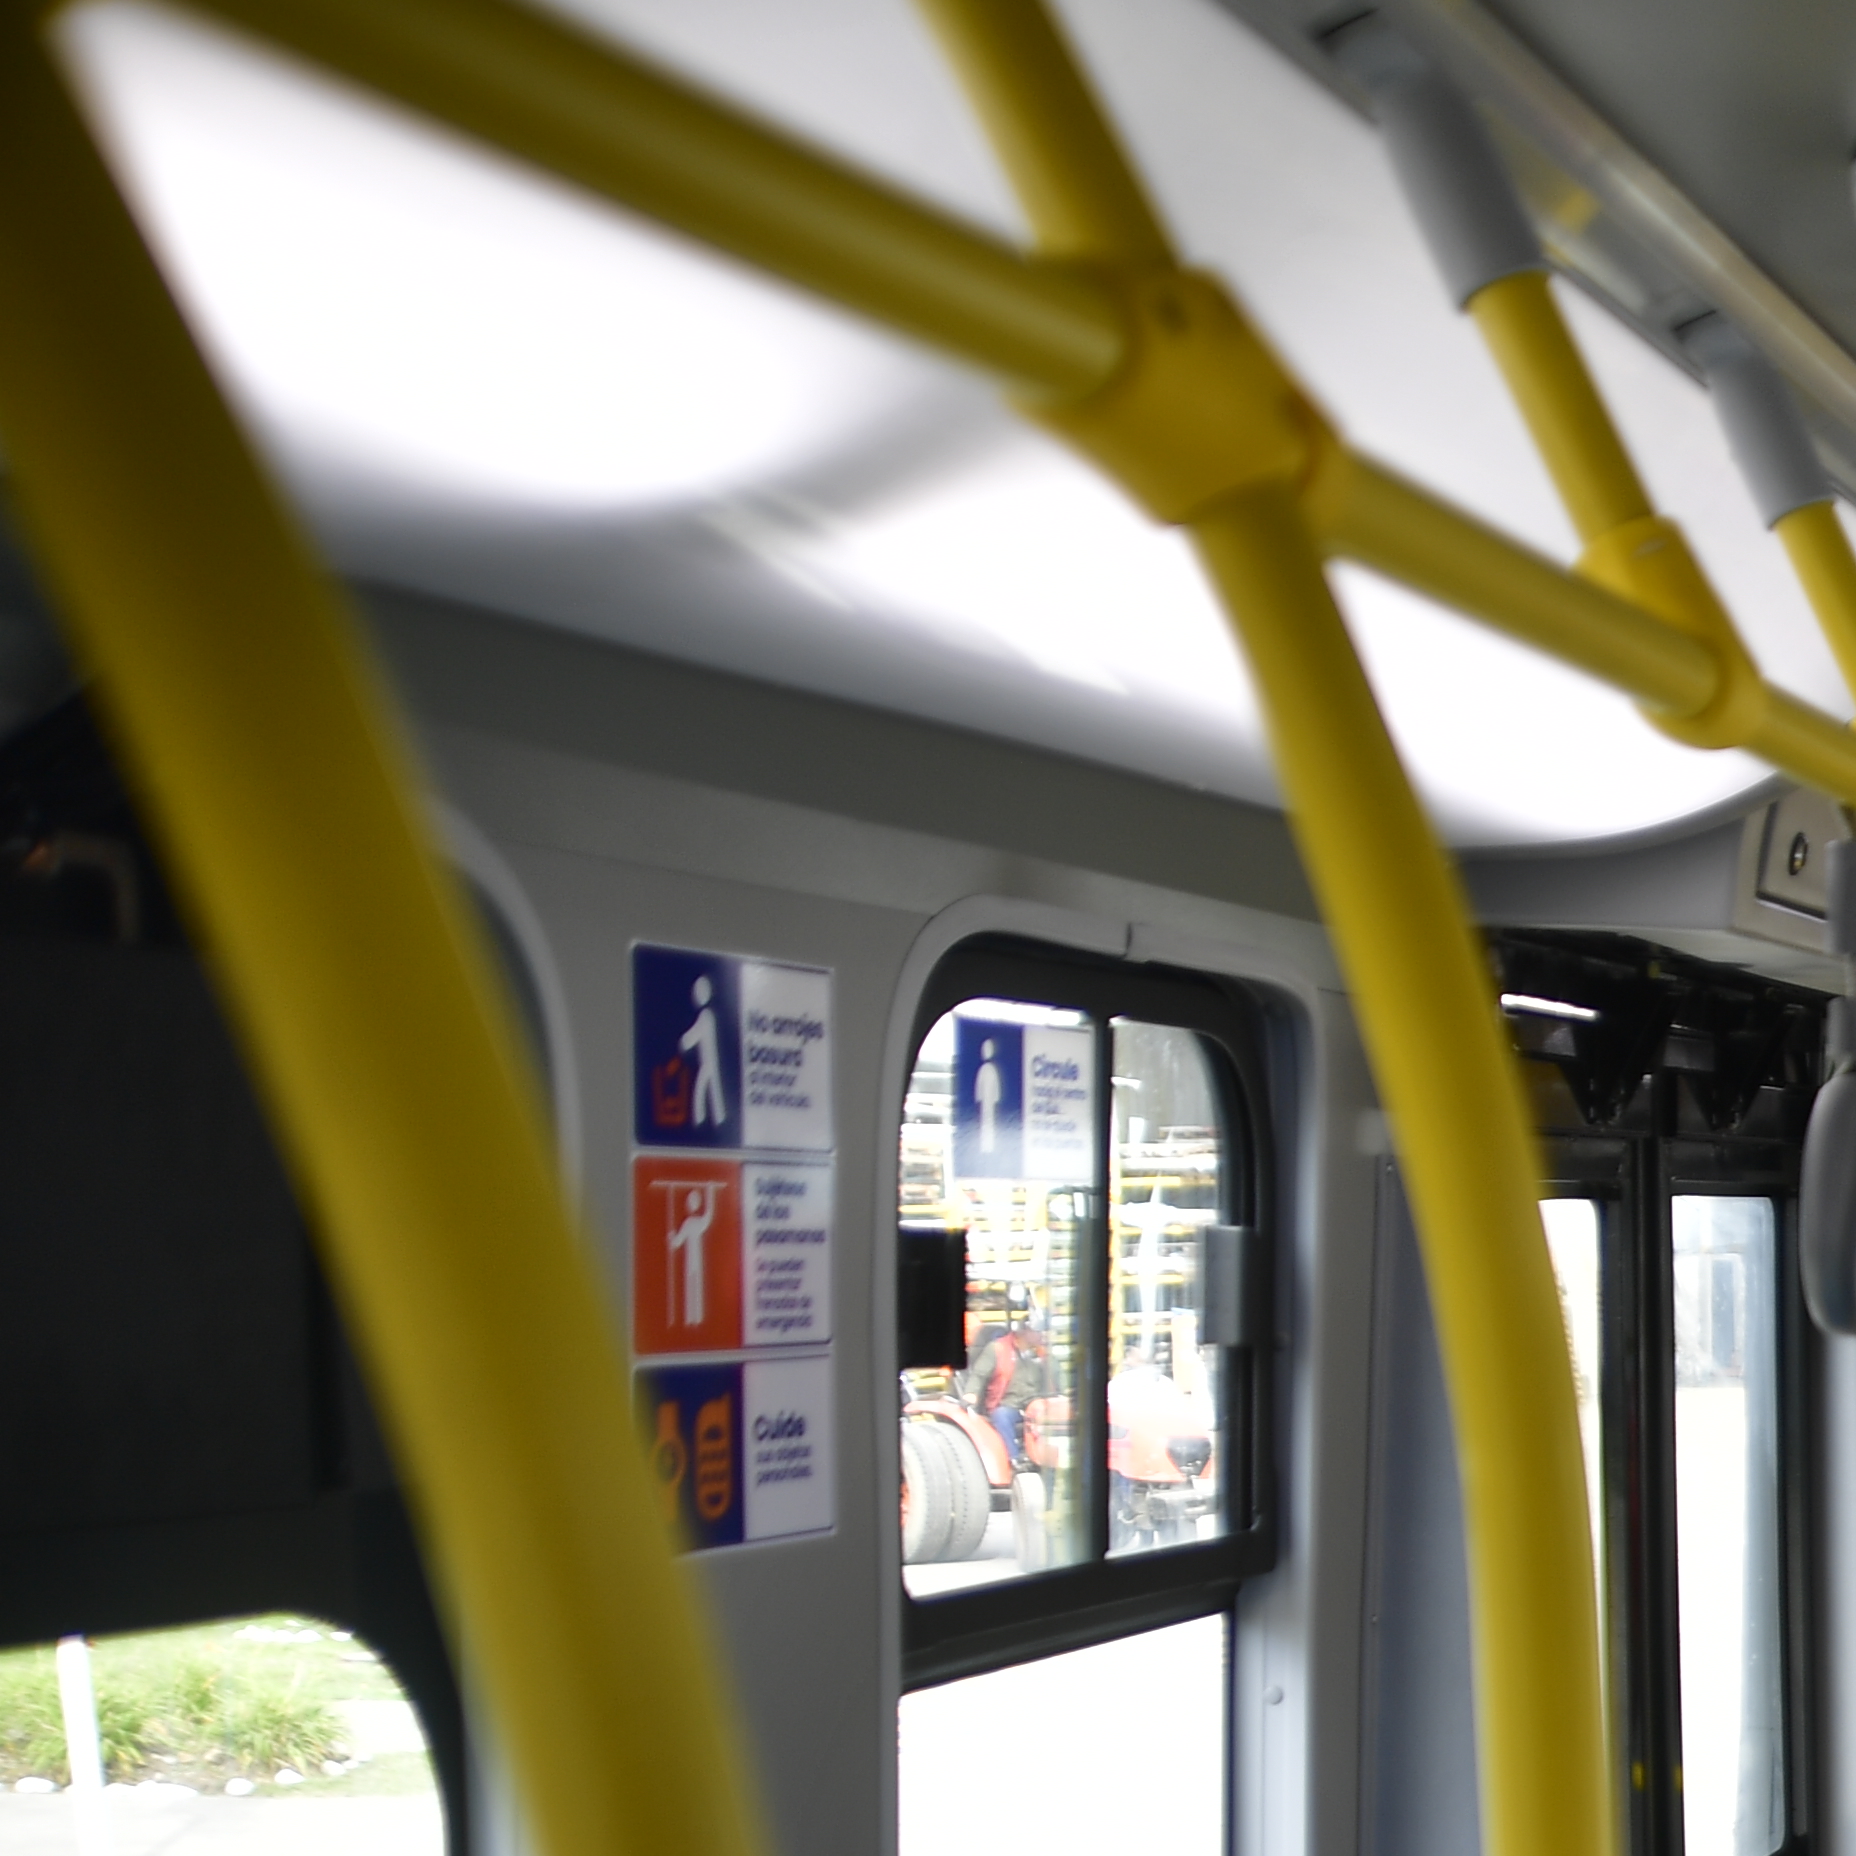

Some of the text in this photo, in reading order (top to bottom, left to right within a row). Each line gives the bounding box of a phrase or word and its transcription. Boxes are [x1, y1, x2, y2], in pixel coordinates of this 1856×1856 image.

[748, 1008, 824, 1045] No arrojes
[749, 1041, 803, 1067] basura
[1031, 1053, 1078, 1081] Circule
